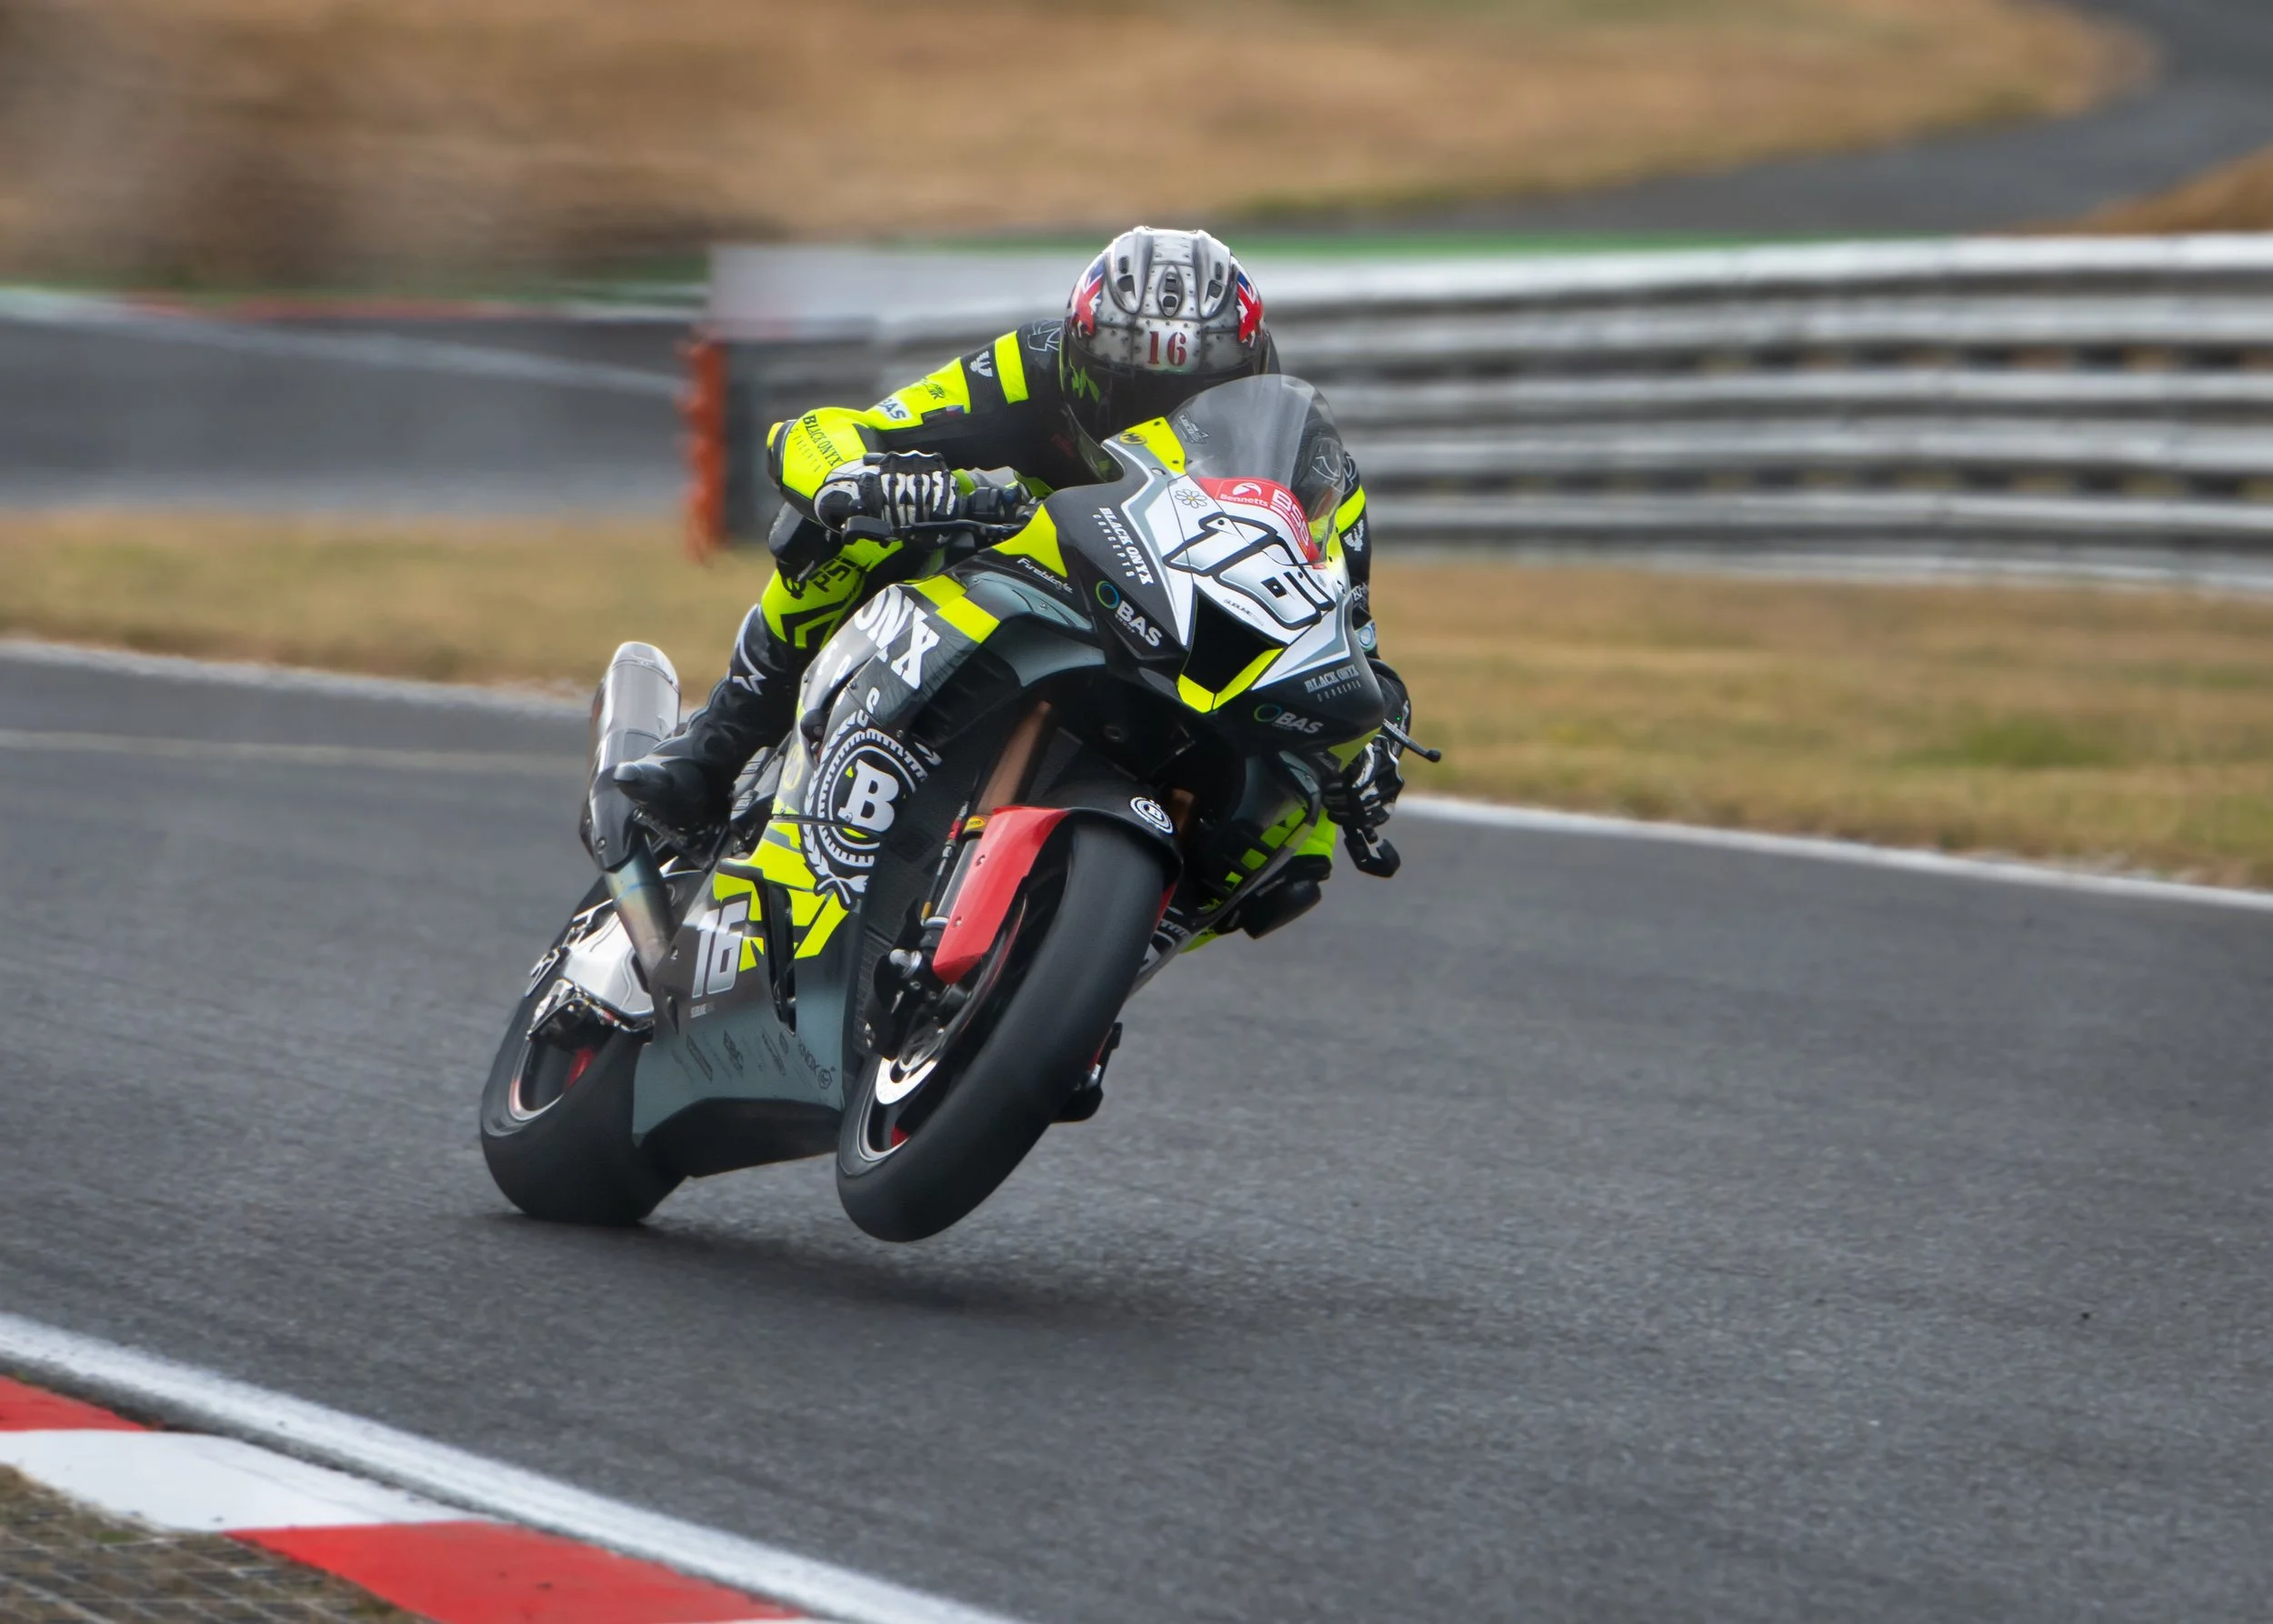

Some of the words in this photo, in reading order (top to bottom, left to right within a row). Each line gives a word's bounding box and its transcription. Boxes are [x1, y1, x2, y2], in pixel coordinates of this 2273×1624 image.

[1148, 330, 1187, 366] 16
[803, 414, 826, 444] BLACK
[817, 440, 845, 467] ONYX
[1219, 493, 1269, 507] Bennetts
[1092, 514, 1136, 577] CONCEPTS
[1097, 506, 1135, 546] BLACK
[1126, 546, 1155, 585] ONYX
[1163, 512, 1337, 630] 16
[1116, 600, 1163, 647] BAS
[1304, 671, 1340, 693] BLACK
[1336, 664, 1360, 680] ONYX
[1275, 711, 1324, 734] BAS
[839, 759, 900, 833] B
[692, 899, 749, 999] 16
